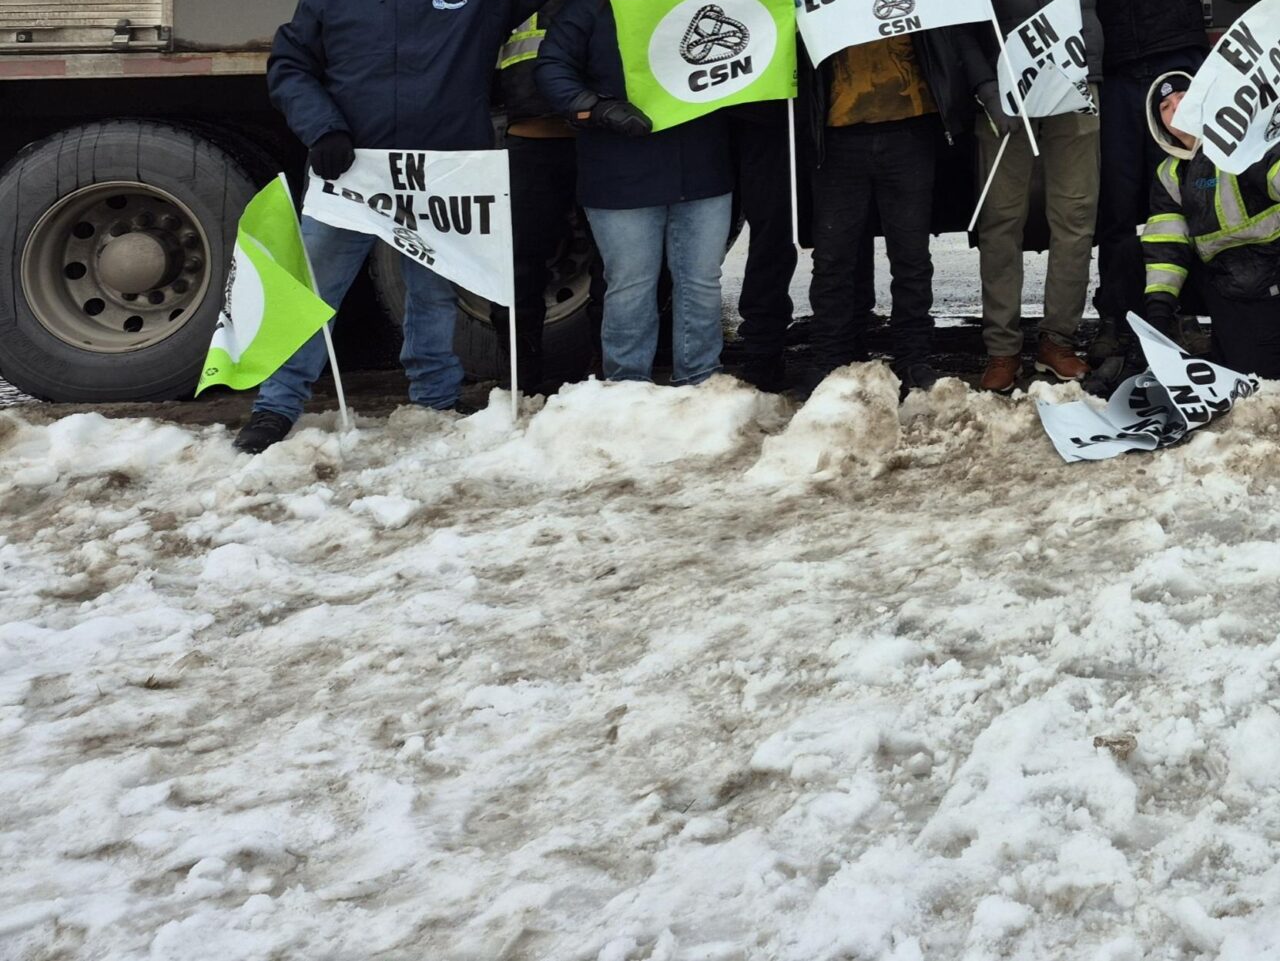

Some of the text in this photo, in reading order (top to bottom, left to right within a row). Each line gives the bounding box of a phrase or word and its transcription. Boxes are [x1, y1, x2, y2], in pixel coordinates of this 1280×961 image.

[879, 16, 921, 36] CSN
[1017, 13, 1060, 59] EN
[1217, 21, 1264, 75] EN
[688, 55, 753, 93] CSN
[388, 152, 426, 191] EN
